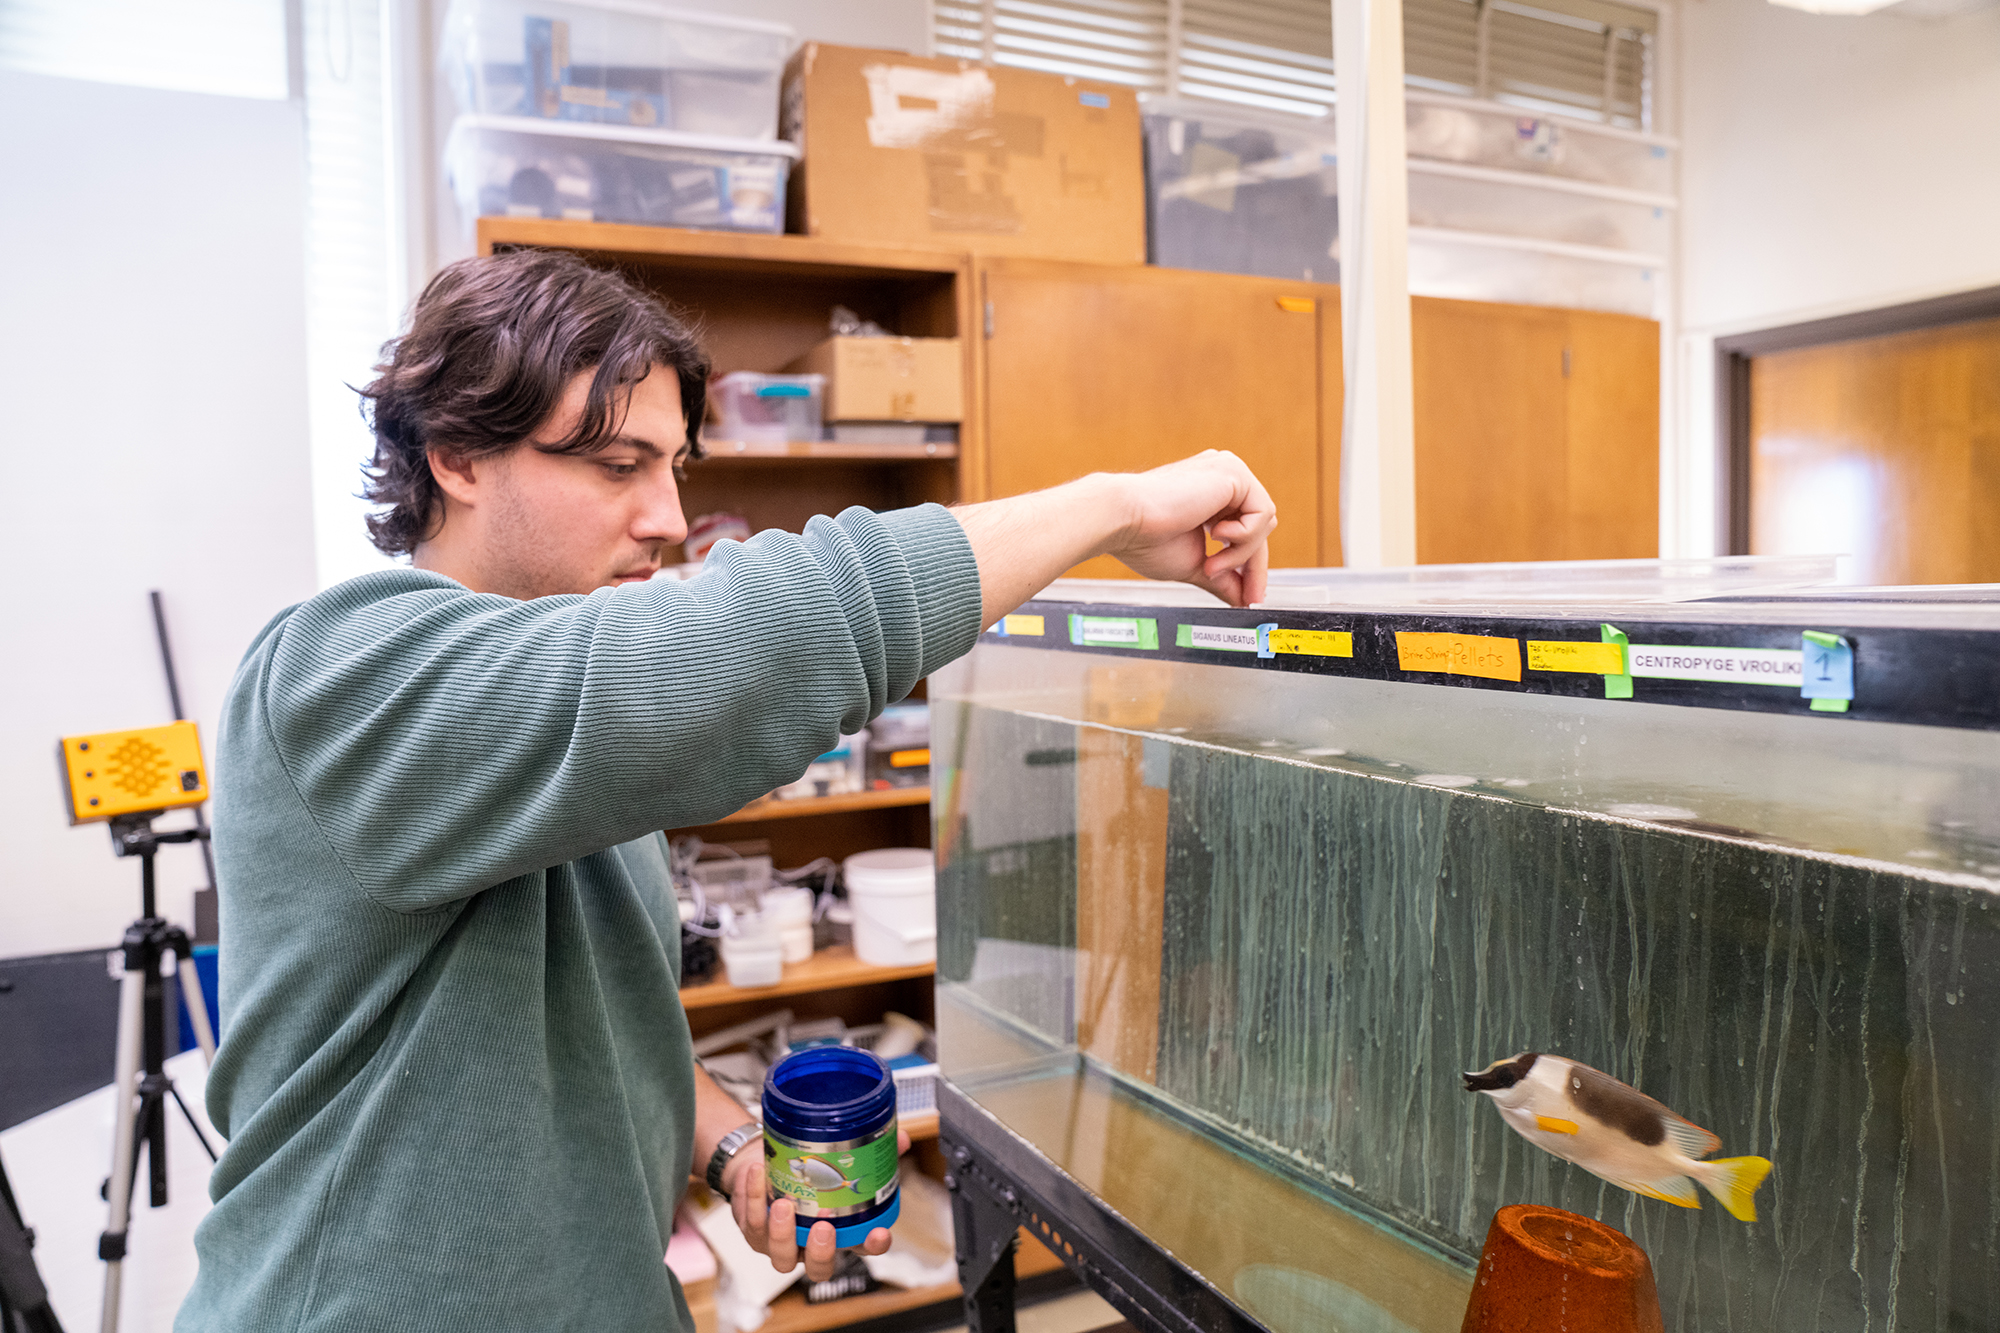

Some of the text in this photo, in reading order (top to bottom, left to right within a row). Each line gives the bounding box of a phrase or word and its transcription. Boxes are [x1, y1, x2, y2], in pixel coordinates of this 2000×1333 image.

[1192, 632, 1256, 645] SIGANUS LINEATUS
[1401, 646, 1423, 661] Brine
[1453, 642, 1505, 668] Pellets
[1635, 654, 1735, 672] CENTROPYGE
[1814, 652, 1833, 681] 1
